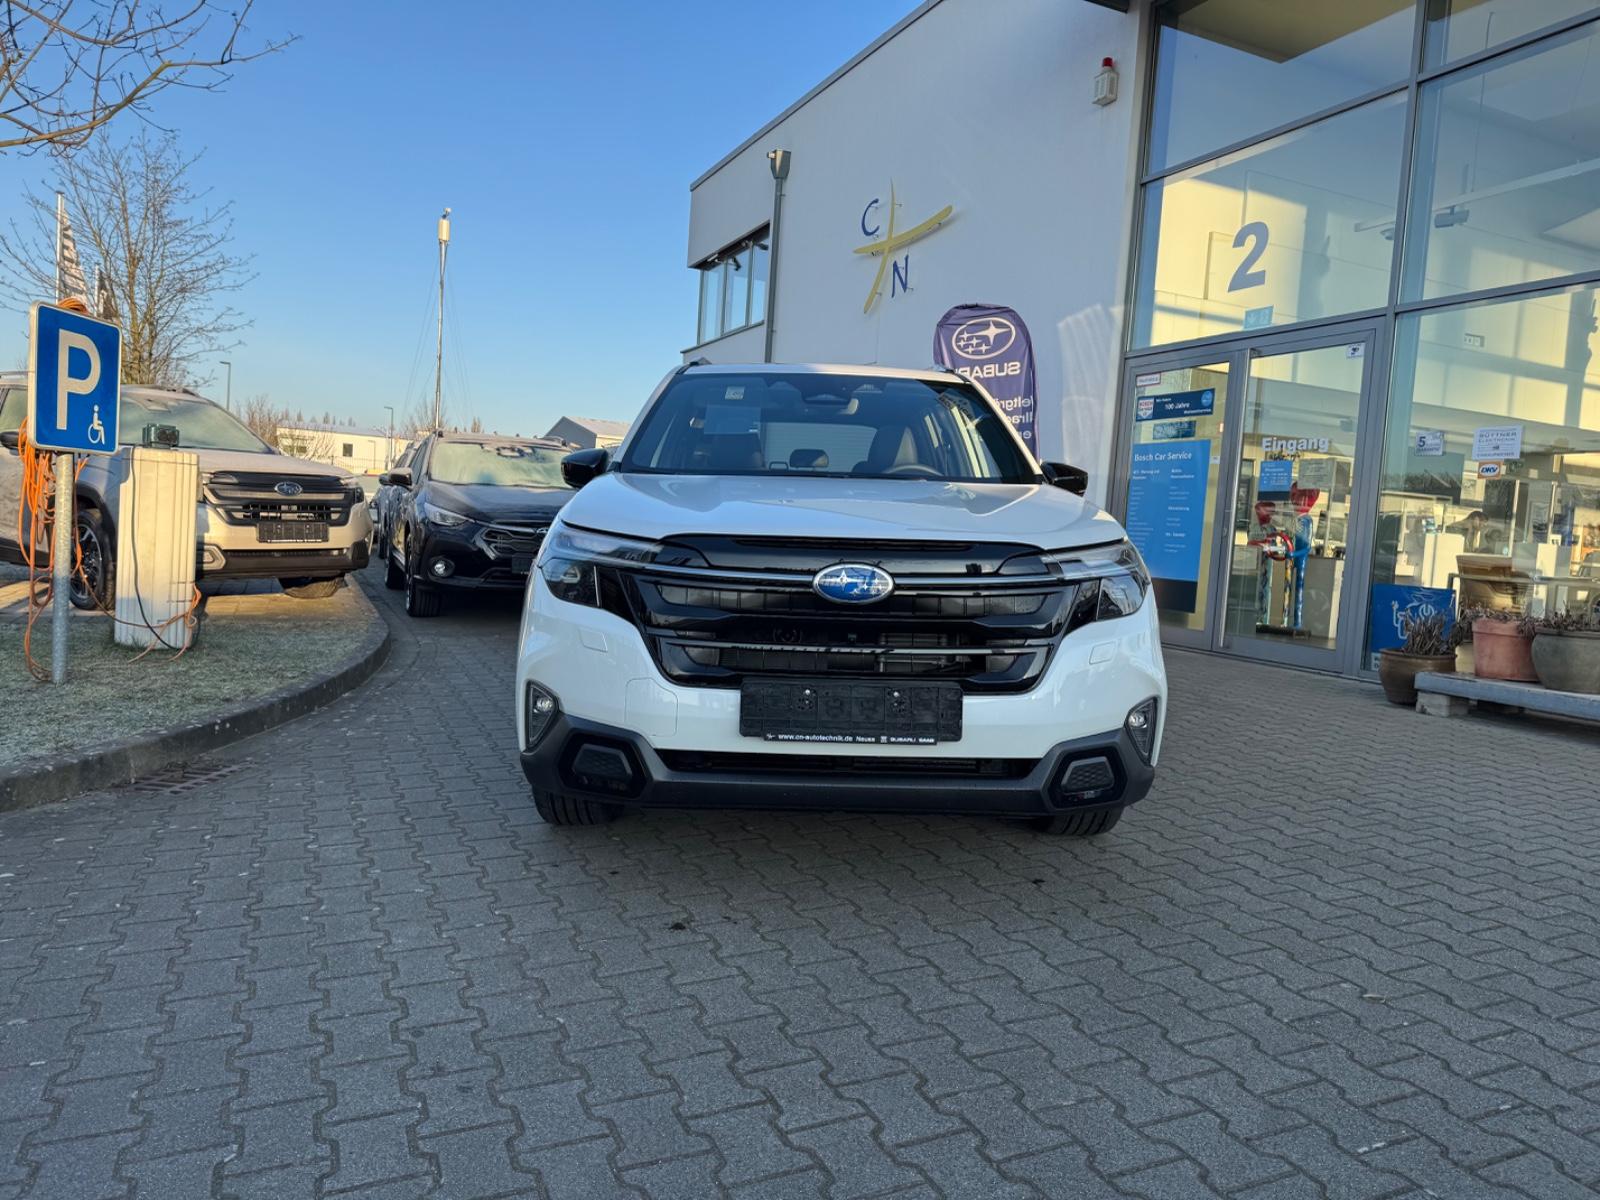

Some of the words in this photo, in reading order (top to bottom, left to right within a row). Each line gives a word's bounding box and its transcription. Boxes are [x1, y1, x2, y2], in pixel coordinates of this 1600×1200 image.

[861, 198, 880, 237] C
[1227, 221, 1270, 293] 2
[891, 254, 909, 298] N
[56, 328, 101, 431] P
[1134, 453, 1153, 461] Bosch
[1154, 452, 1166, 460] Car
[1167, 451, 1192, 460] Service
[1262, 436, 1329, 454] Eingang
[1417, 436, 1427, 448] 5
[778, 734, 853, 742] www.cn-autotechnik.de
